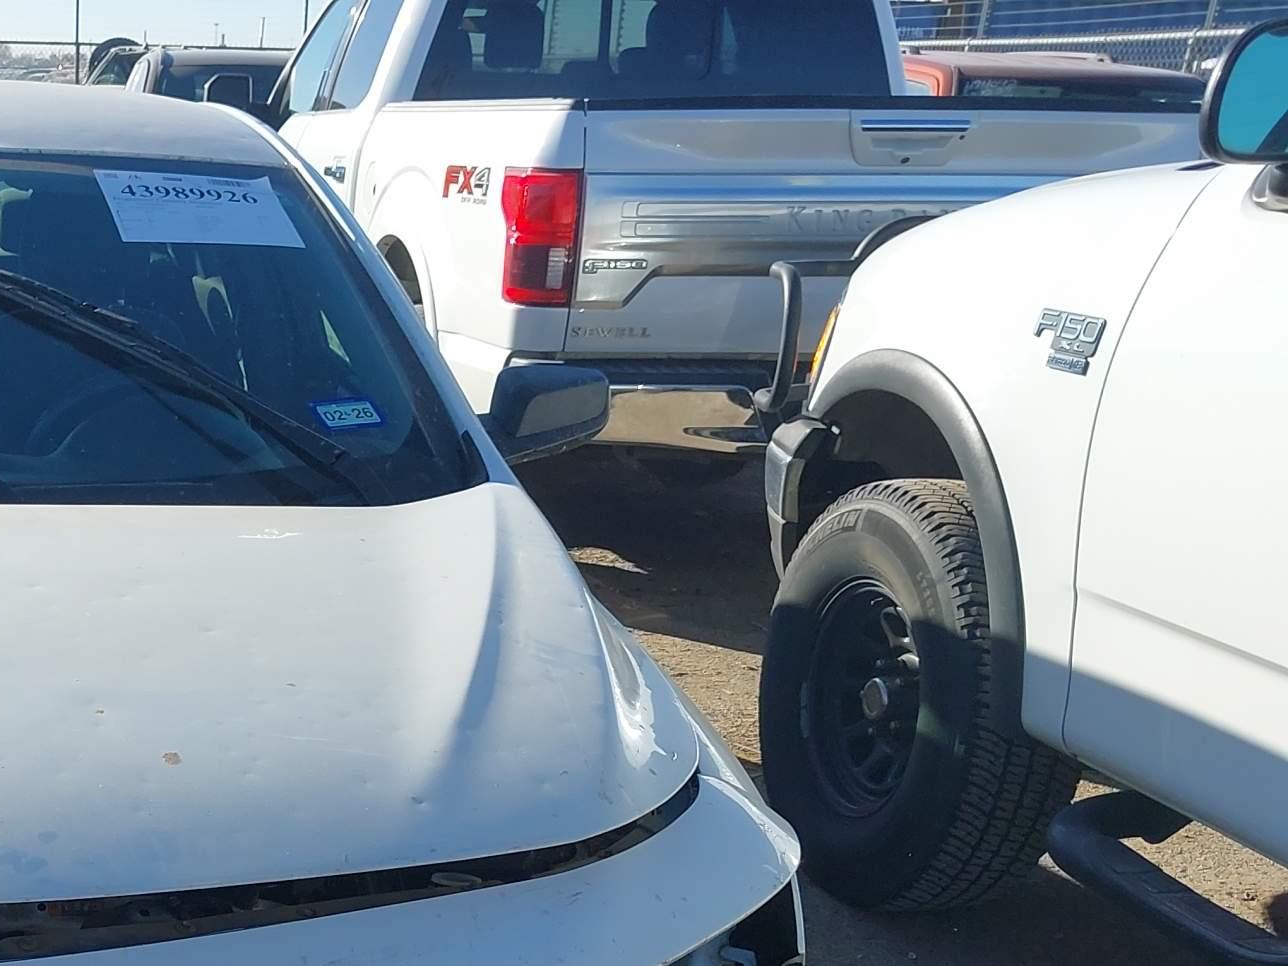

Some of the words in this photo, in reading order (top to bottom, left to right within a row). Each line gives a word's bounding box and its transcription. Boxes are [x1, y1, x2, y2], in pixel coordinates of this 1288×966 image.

[442, 165, 491, 198] FX4
[120, 184, 258, 204] 43989926
[786, 206, 873, 232] KING
[571, 327, 651, 338] SEWELL
[1059, 340, 1085, 353] XL
